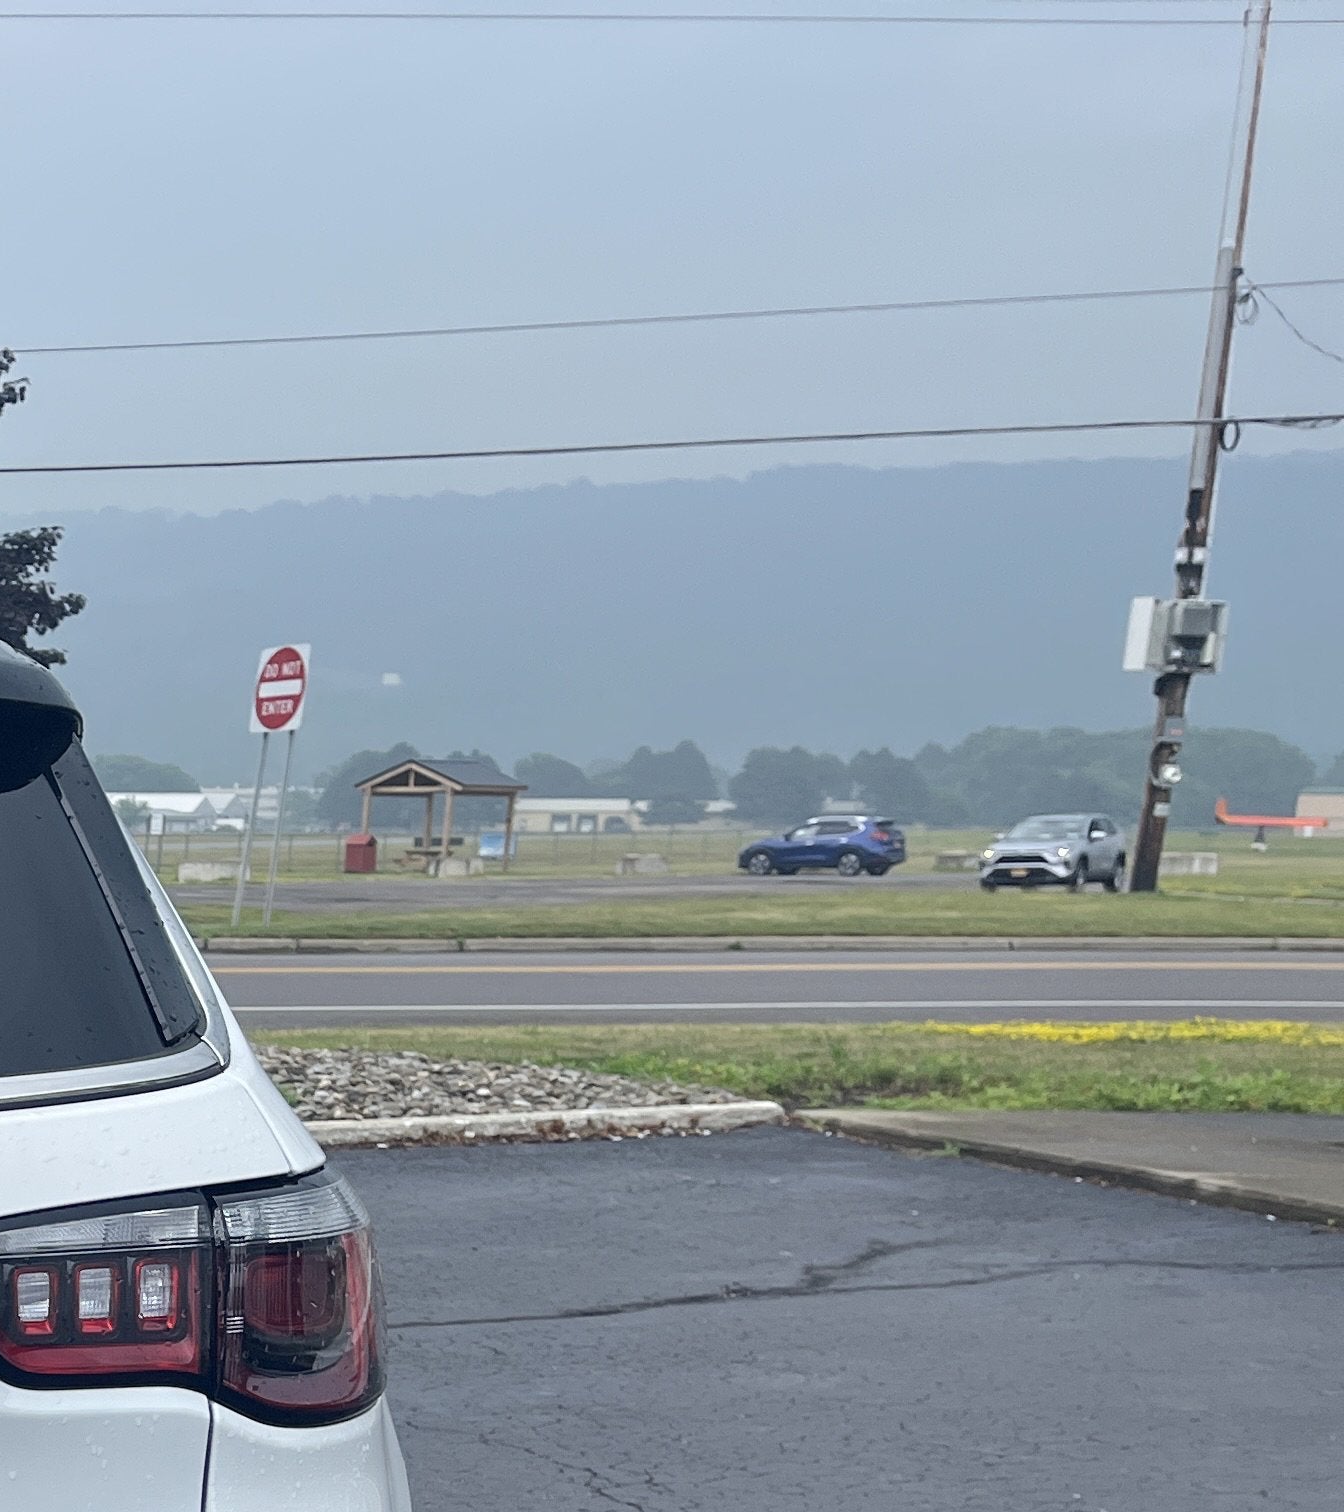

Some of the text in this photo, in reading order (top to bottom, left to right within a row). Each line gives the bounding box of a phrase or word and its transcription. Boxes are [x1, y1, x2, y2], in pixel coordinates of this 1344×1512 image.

[263, 660, 301, 678] DO NOT
[261, 700, 294, 716] ENTER
